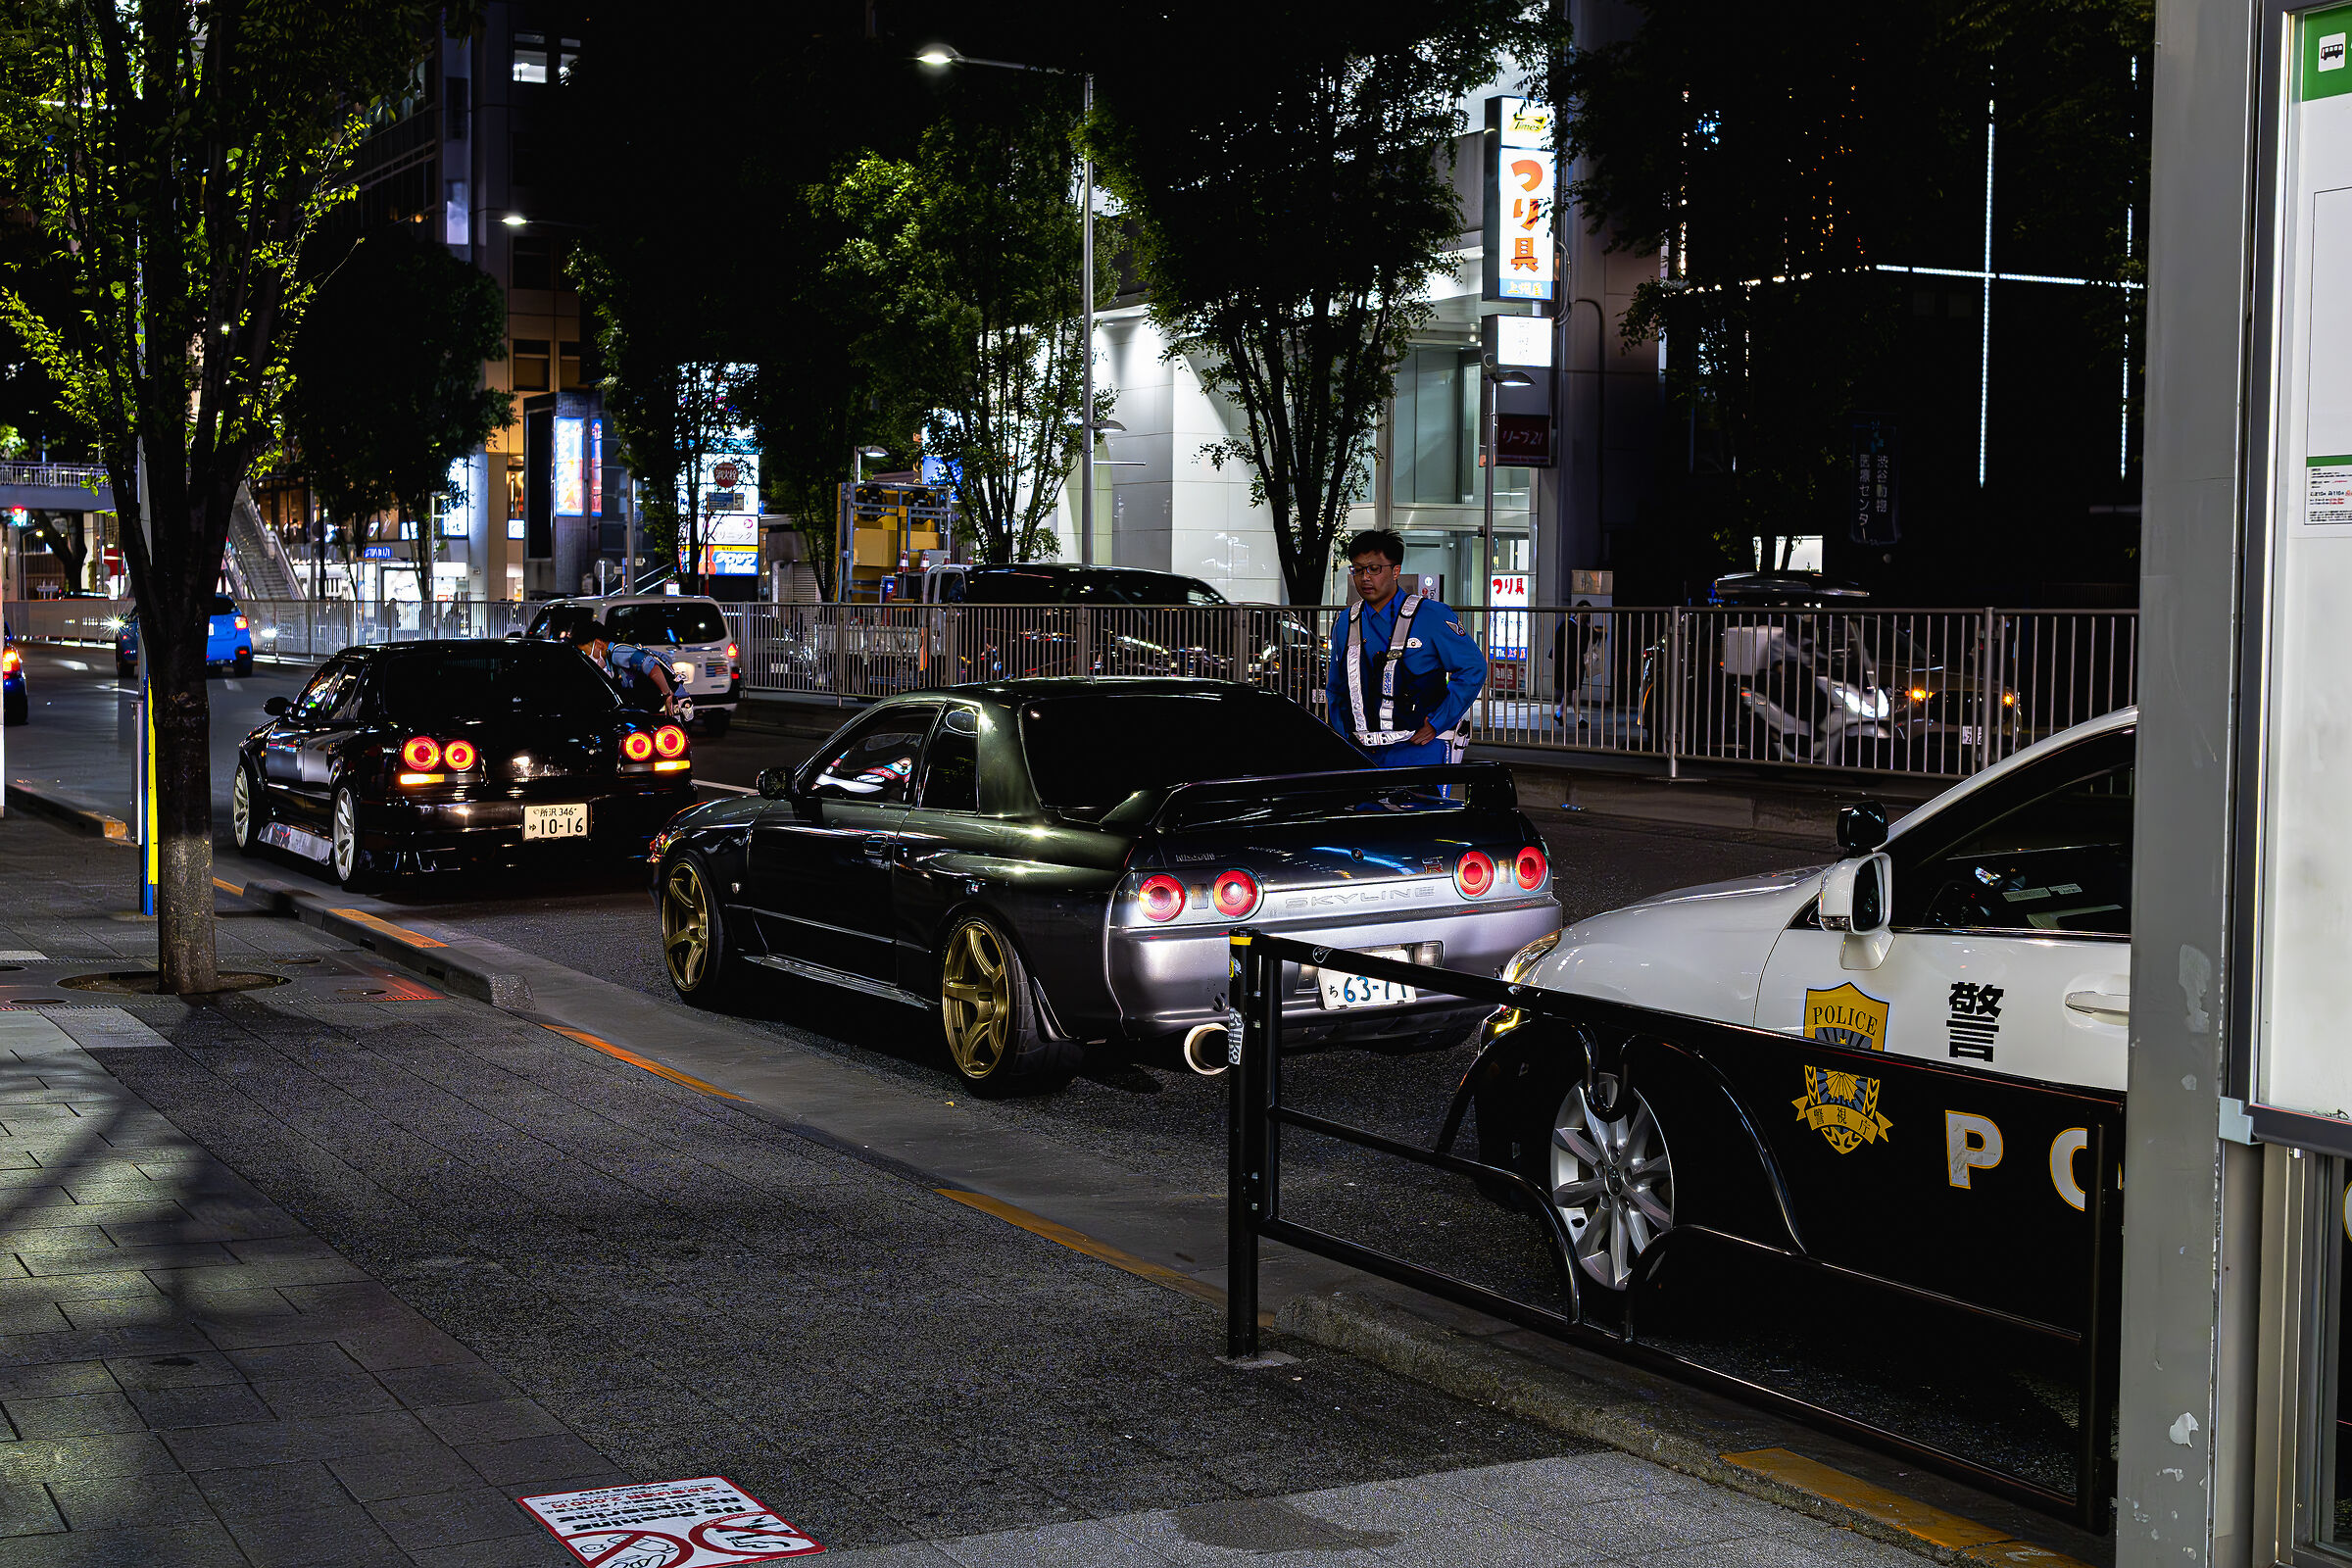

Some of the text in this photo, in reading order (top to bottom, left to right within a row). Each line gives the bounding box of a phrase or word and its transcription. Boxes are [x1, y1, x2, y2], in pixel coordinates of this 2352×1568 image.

[1510, 159, 1544, 272] つり具
[715, 469, 738, 481] 消火栓
[715, 552, 758, 564] クロサワ
[1493, 577, 1524, 595] つり具
[540, 807, 574, 817] 所沢 346
[541, 817, 583, 835] 10-16
[1285, 886, 1435, 909] SKYLINE
[1328, 984, 1339, 999] ち
[1812, 1004, 1878, 1036] POLICE
[1945, 981, 2005, 1063] 警
[1813, 1106, 1871, 1137] 警視庁
[698, 1495, 742, 1507] No
[702, 1504, 748, 1516] No
